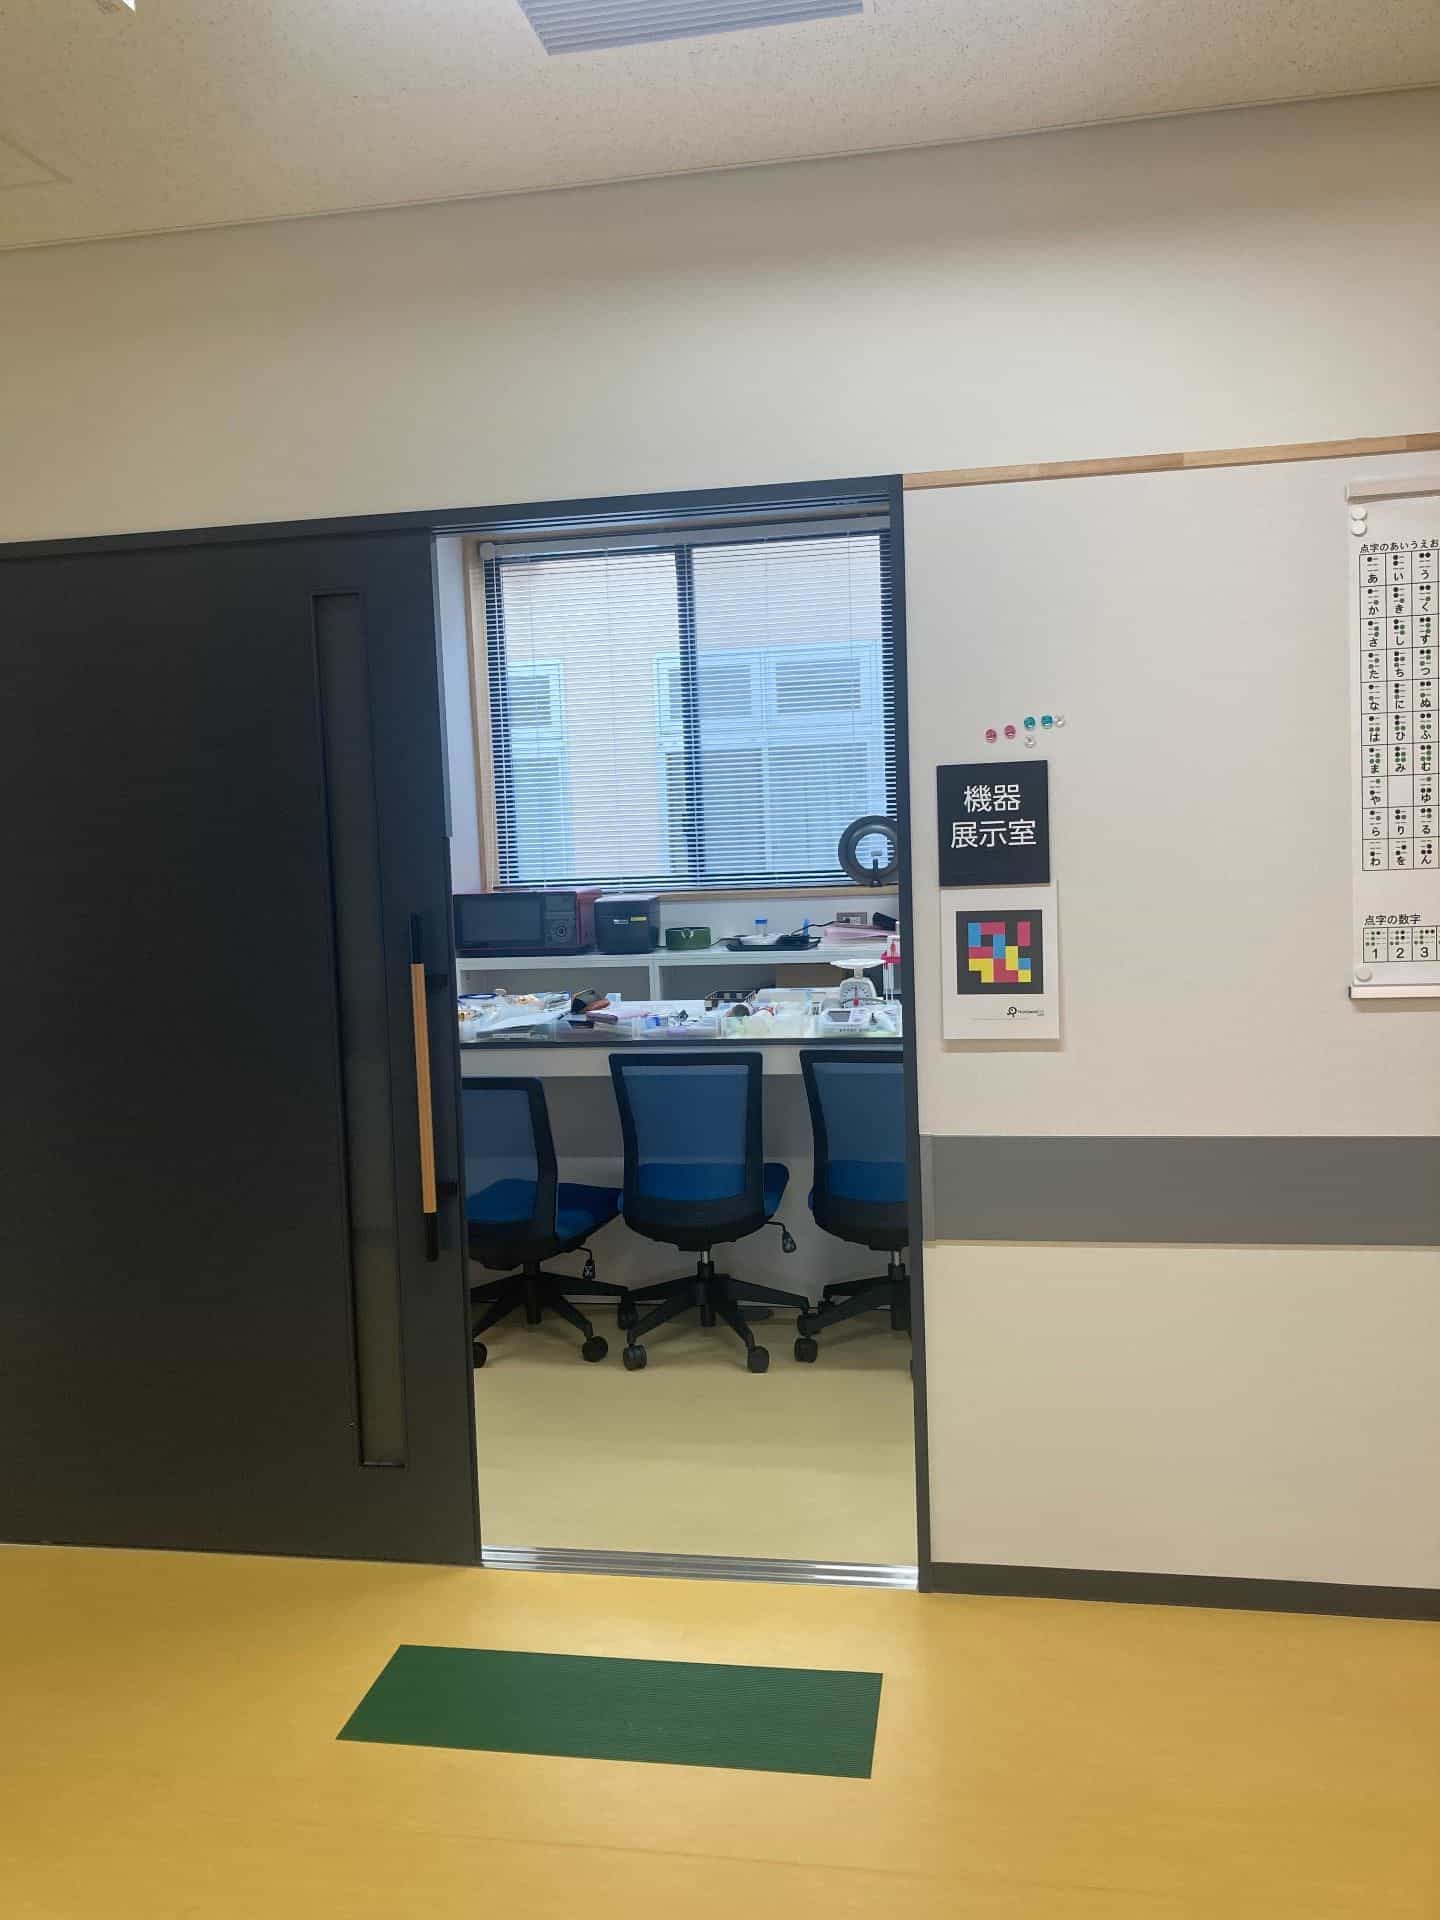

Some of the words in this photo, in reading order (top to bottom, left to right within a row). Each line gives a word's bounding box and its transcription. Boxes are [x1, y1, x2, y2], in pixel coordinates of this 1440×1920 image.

[1359, 539, 1439, 553] 点字のあいうえお
[1368, 574, 1378, 583] あ
[1394, 572, 1404, 581] い
[1421, 569, 1430, 580] う
[1369, 605, 1379, 615] か
[1395, 604, 1404, 614] き
[1422, 602, 1429, 612] く
[1369, 637, 1379, 647] さ
[1396, 636, 1405, 646] し
[1421, 632, 1431, 644] す
[1369, 669, 1380, 679] た
[1395, 668, 1405, 678] ち
[1421, 666, 1431, 676] つ
[1369, 701, 1380, 711] な
[1395, 699, 1405, 710] に
[1420, 698, 1431, 709] ぬ
[1369, 732, 1381, 742] は
[1395, 731, 1405, 741] ひ
[1421, 729, 1432, 740] ふ
[1370, 763, 1380, 774] ま
[1395, 762, 1406, 773] み
[1421, 761, 1431, 772] む
[963, 784, 1021, 813] 機器
[1370, 795, 1381, 805] や
[1421, 793, 1431, 804] ゆ
[950, 818, 1037, 849] 展示室
[1371, 827, 1380, 836] ら
[1397, 825, 1405, 835] り
[1422, 824, 1431, 835] る
[1370, 856, 1381, 866] わ
[1396, 855, 1406, 866] を
[1421, 854, 1432, 865] ん
[1364, 914, 1421, 925] 点字の数字
[1371, 948, 1379, 959] 1
[1395, 948, 1405, 959] 2
[1420, 947, 1430, 958] 3
